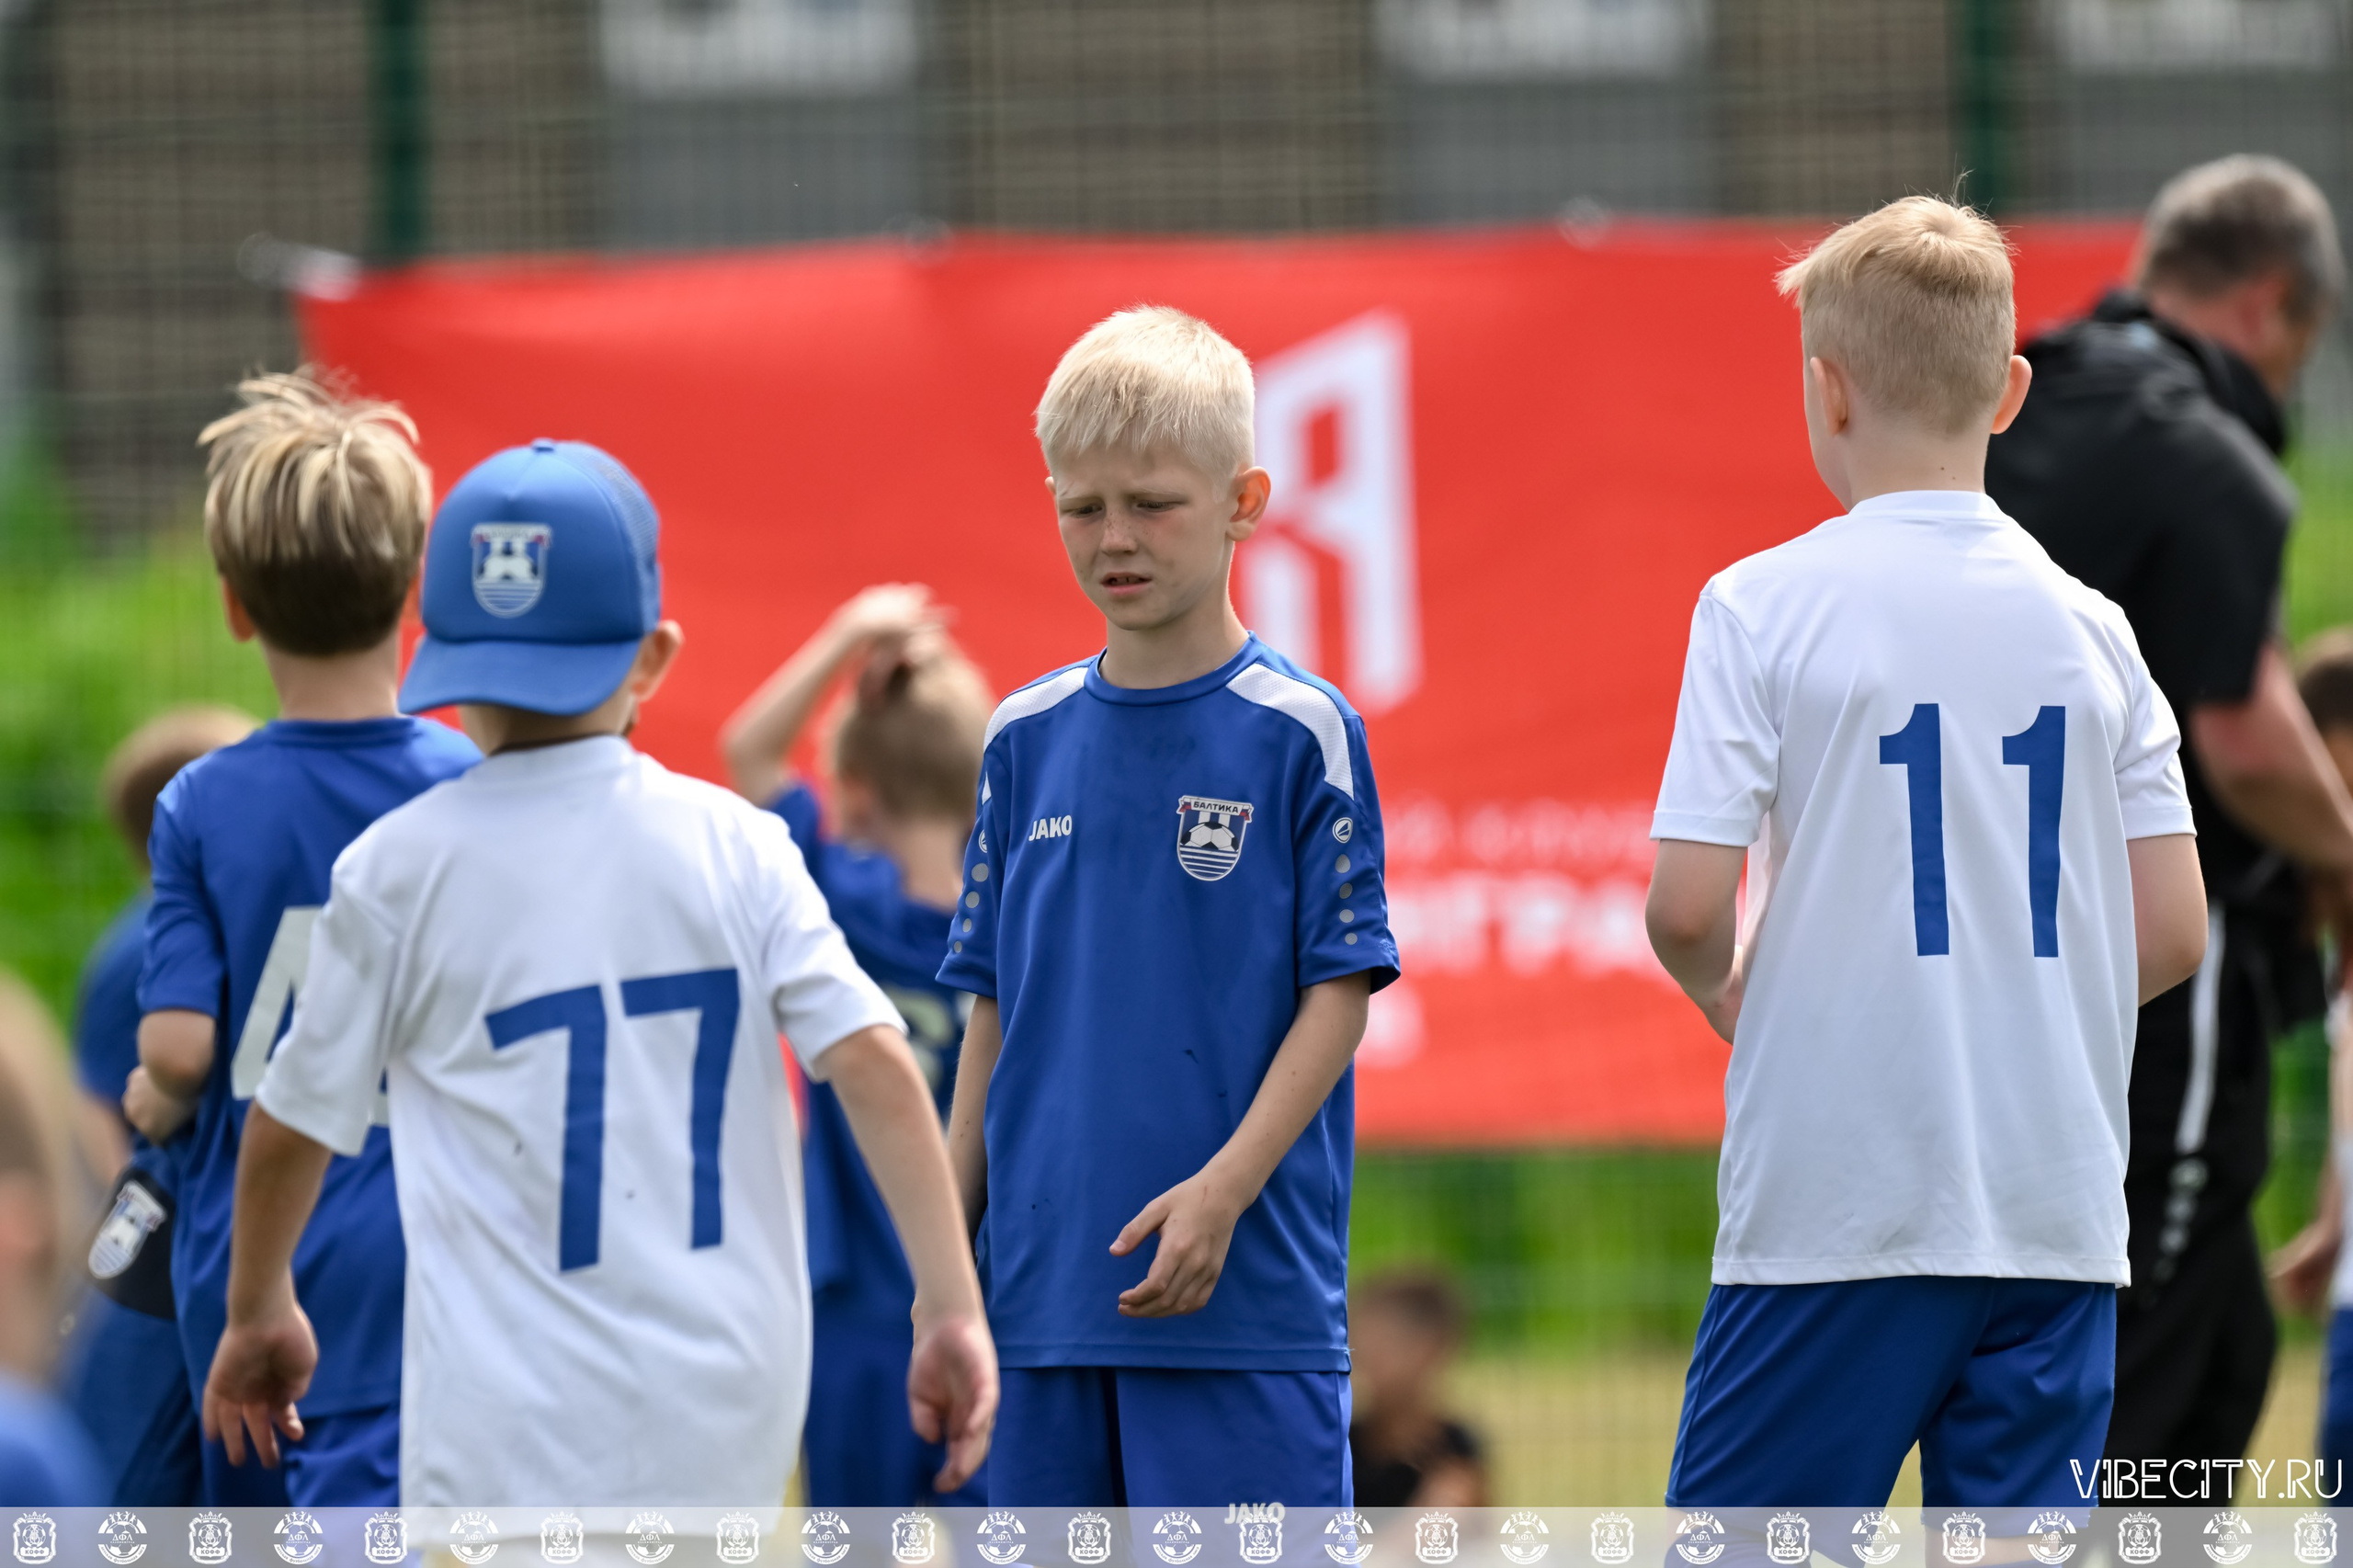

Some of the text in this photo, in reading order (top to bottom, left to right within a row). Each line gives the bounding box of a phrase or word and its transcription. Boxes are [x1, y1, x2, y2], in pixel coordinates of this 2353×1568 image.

[1193, 801, 1239, 813] БАЛТИКА
[1029, 814, 1073, 841] JAKO
[1879, 703, 2065, 957] 11
[484, 968, 741, 1275] 77
[1224, 1502, 1286, 1524] JAKO
